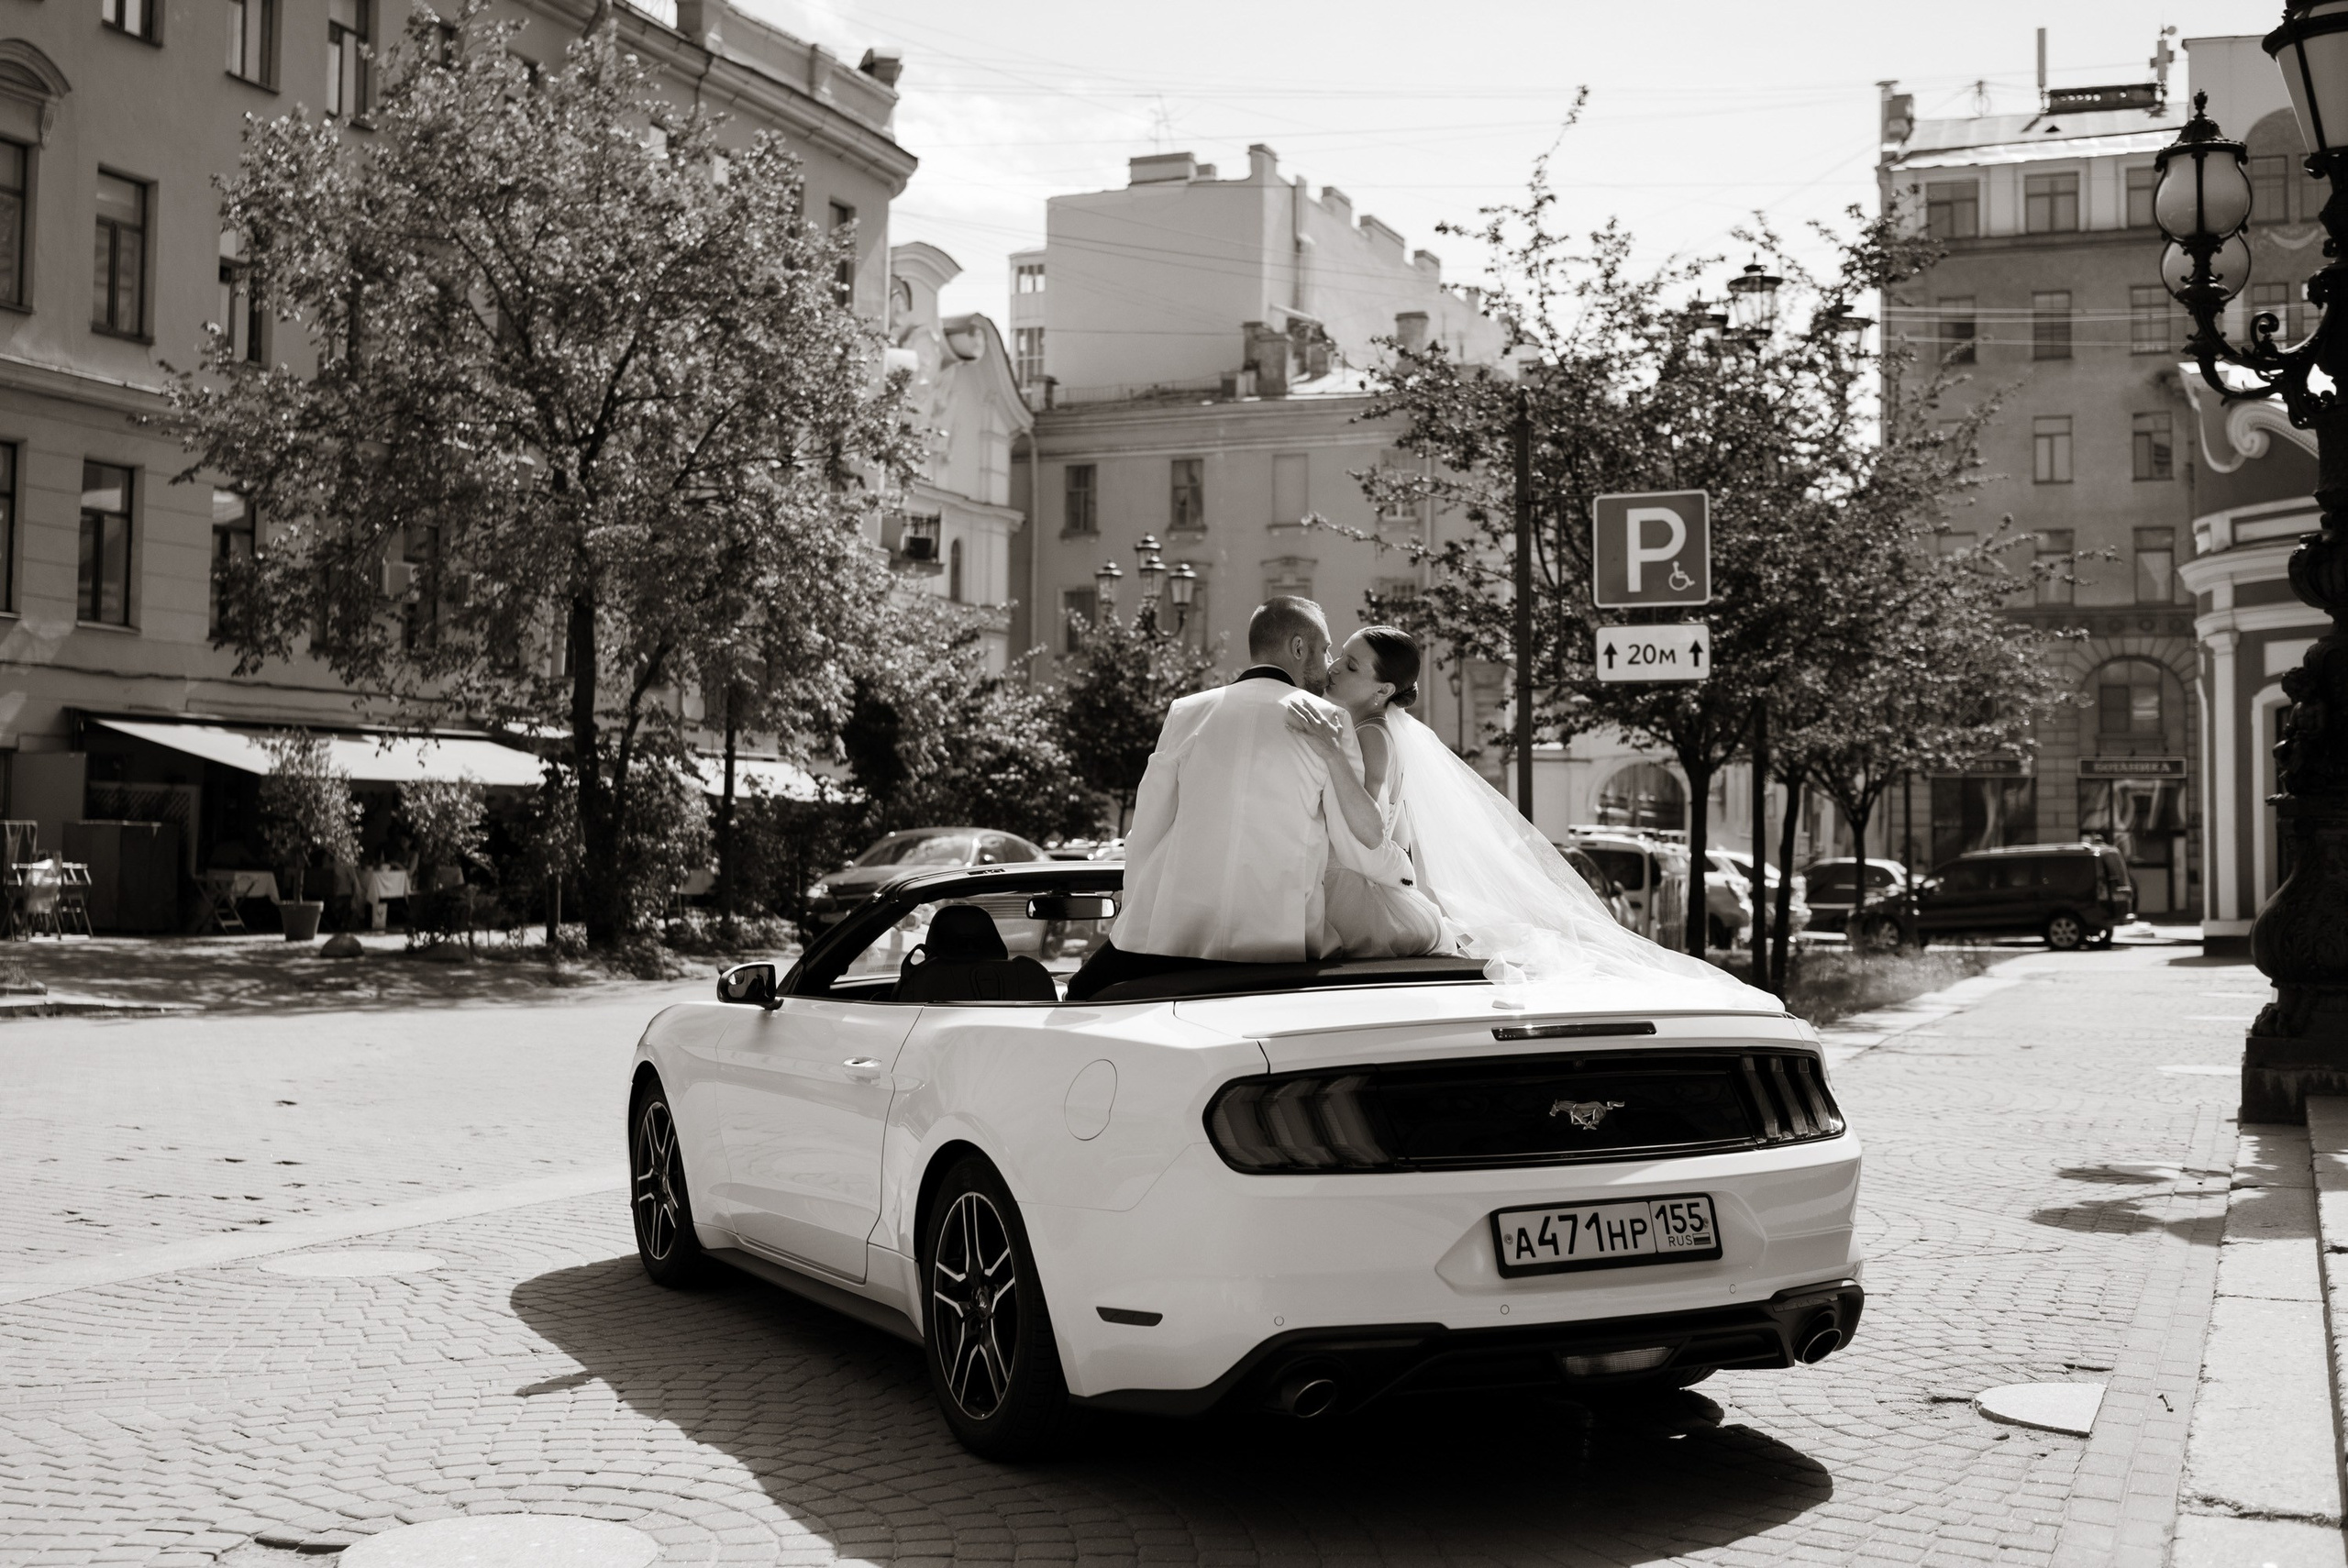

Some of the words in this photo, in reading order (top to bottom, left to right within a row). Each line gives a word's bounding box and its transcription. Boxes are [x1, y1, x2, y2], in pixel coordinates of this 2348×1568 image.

[1626, 506, 1687, 592] P
[1655, 1202, 1704, 1235] 155
[1667, 1234, 1693, 1247] RUS
